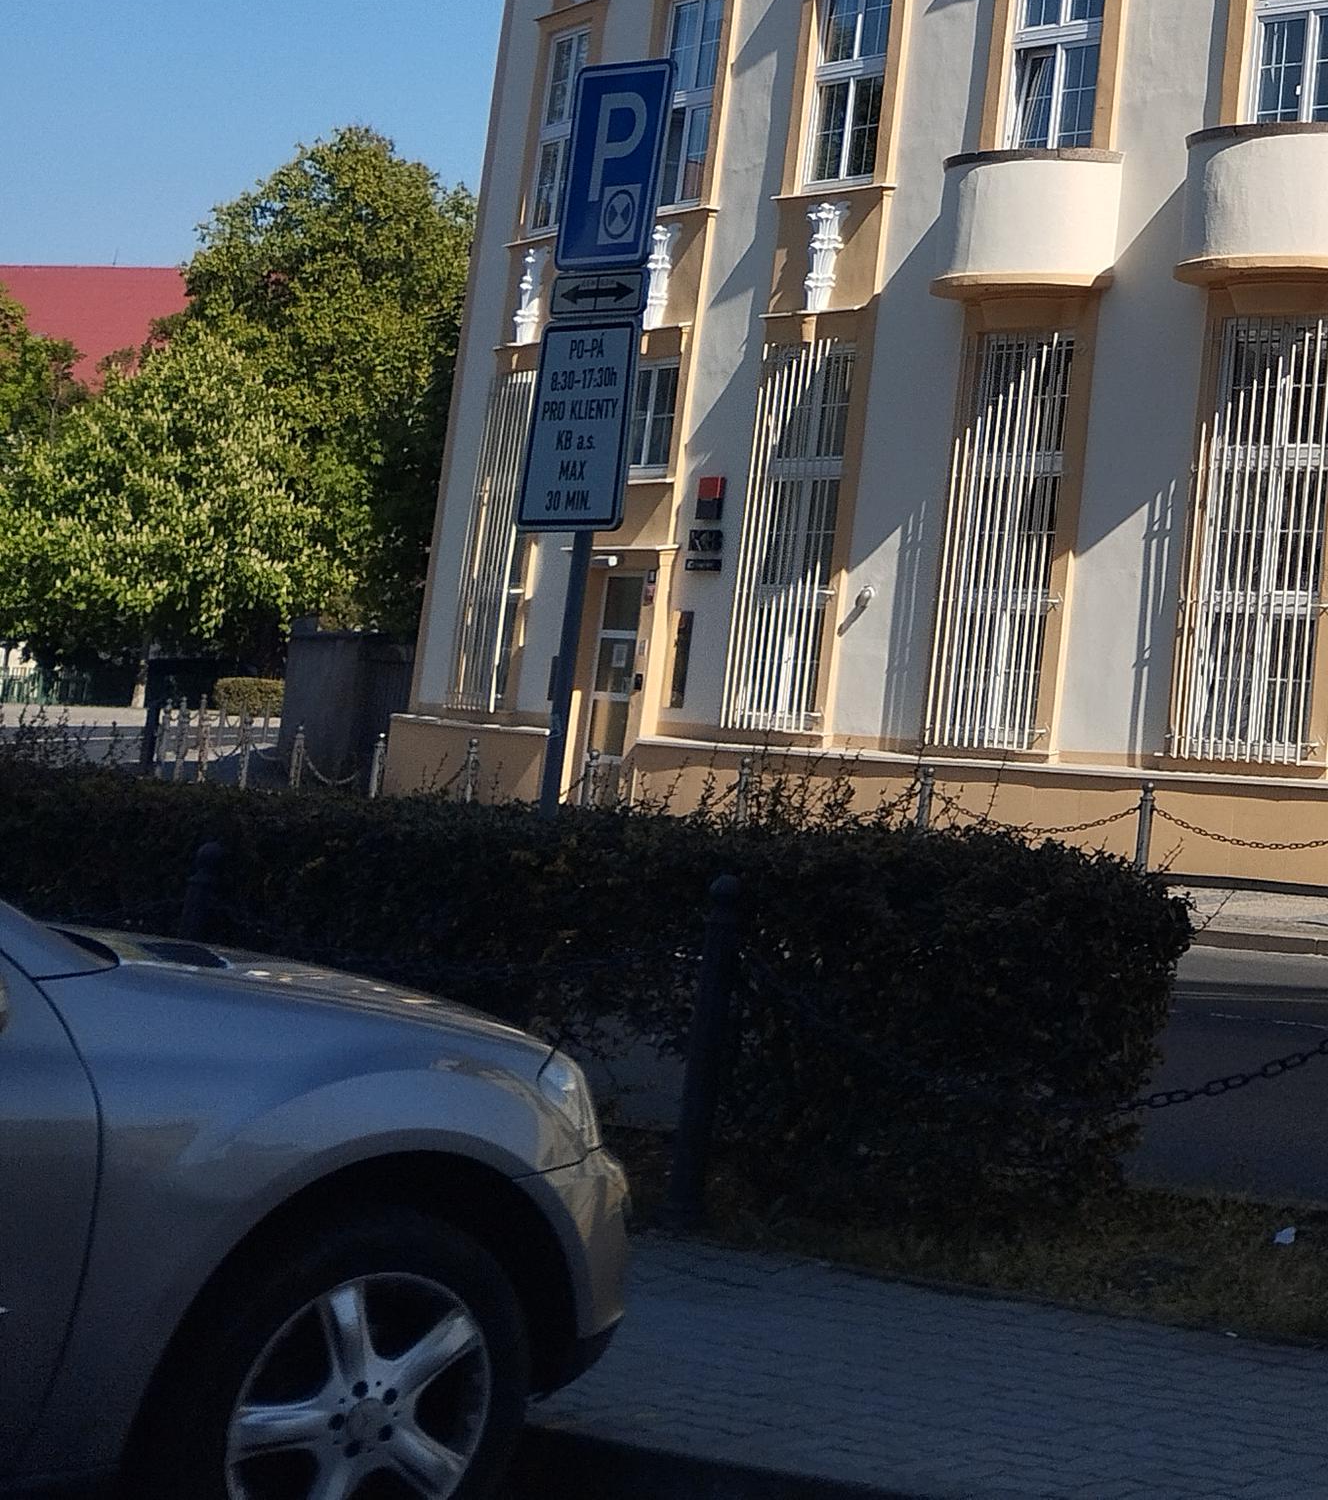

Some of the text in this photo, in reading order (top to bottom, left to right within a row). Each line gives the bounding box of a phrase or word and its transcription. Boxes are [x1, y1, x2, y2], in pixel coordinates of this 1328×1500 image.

[589, 92, 648, 202] P
[542, 398, 619, 422] PRO KLIENTY
[556, 430, 596, 451] KB a.s.
[558, 460, 587, 482] MAX
[545, 490, 591, 512] 30 MIN.
